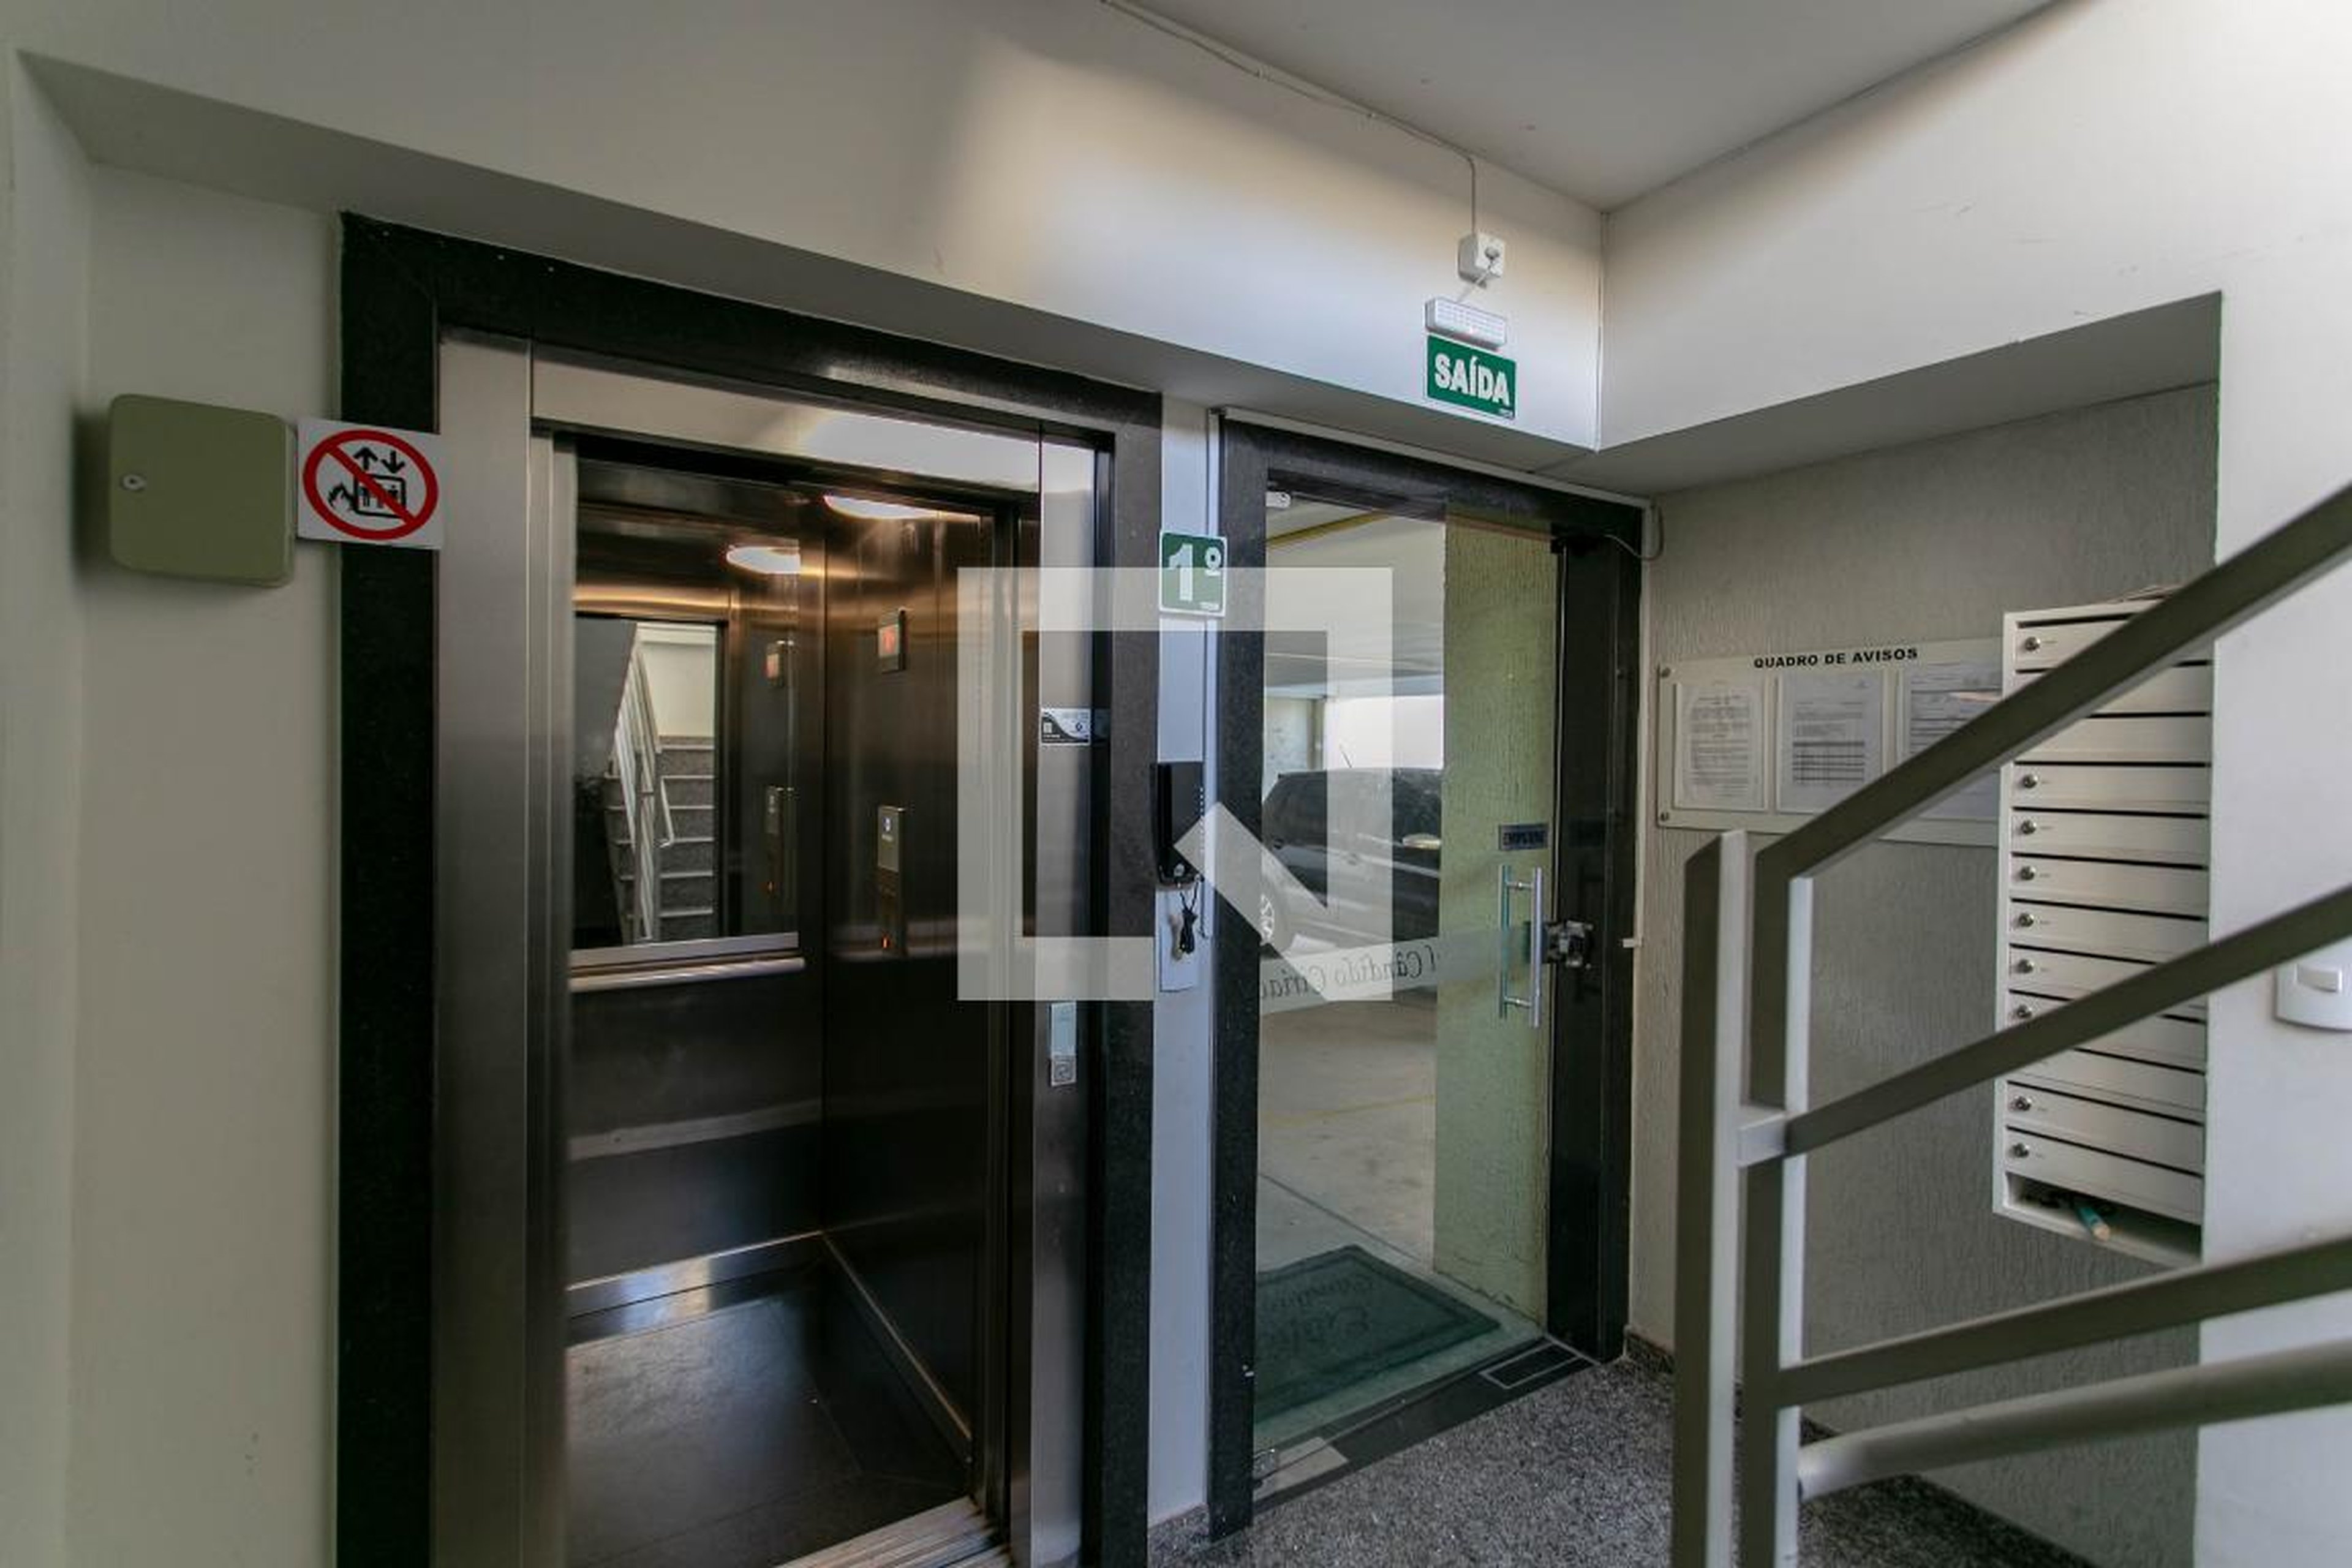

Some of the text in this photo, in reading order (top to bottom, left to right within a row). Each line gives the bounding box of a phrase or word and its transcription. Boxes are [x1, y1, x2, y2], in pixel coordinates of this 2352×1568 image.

[1434, 353, 1510, 407] SAÍDA
[1169, 543, 1222, 601] 1º
[1754, 647, 1918, 668] QUADRO DE AVISOS
